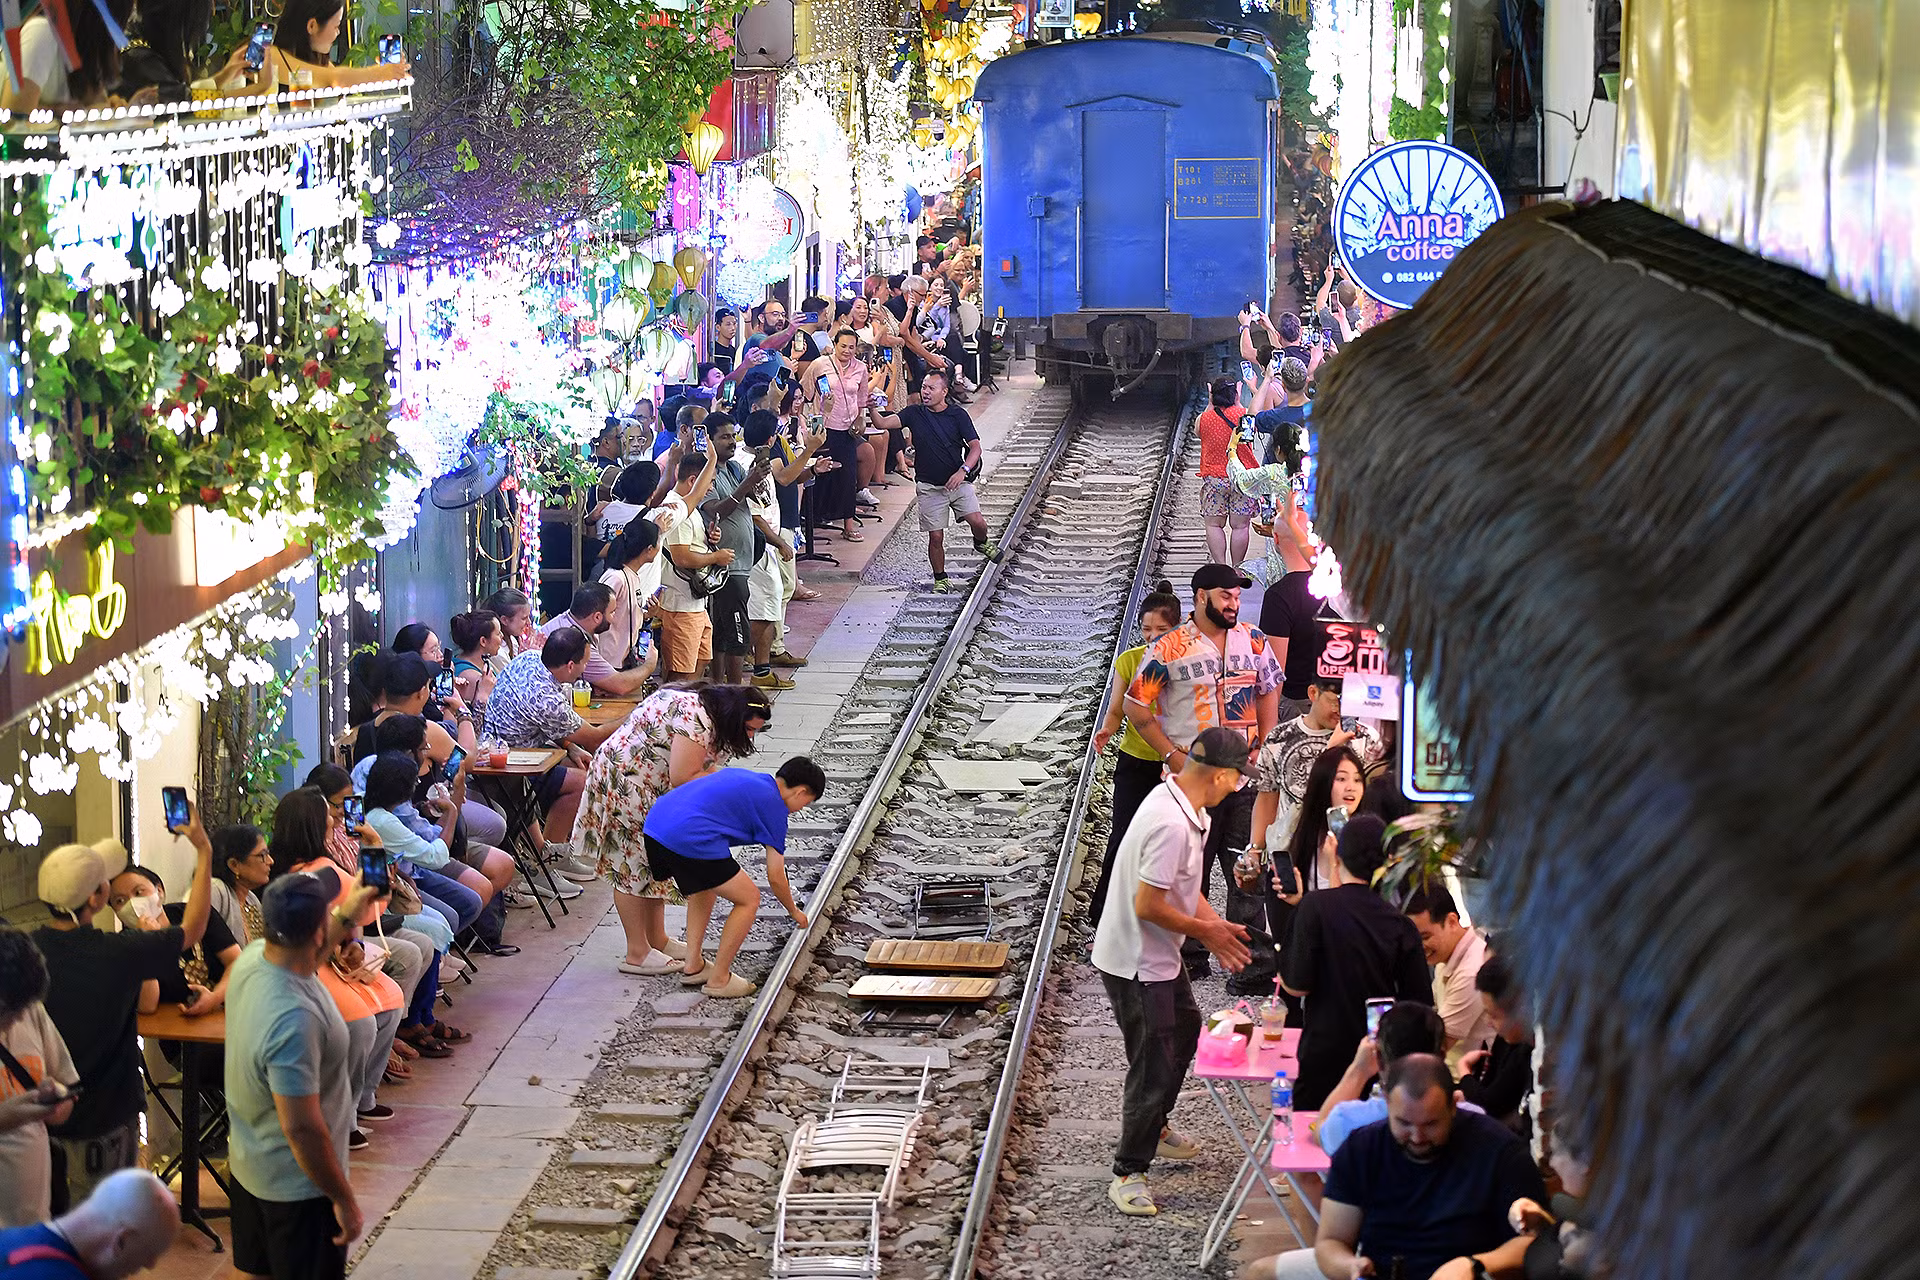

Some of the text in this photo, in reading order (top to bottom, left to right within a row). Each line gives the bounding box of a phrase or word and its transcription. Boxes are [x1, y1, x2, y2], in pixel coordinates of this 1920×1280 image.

[1377, 211, 1464, 240] Anna
[1386, 240, 1455, 262] coffee
[1320, 665, 1355, 675] OPEN
